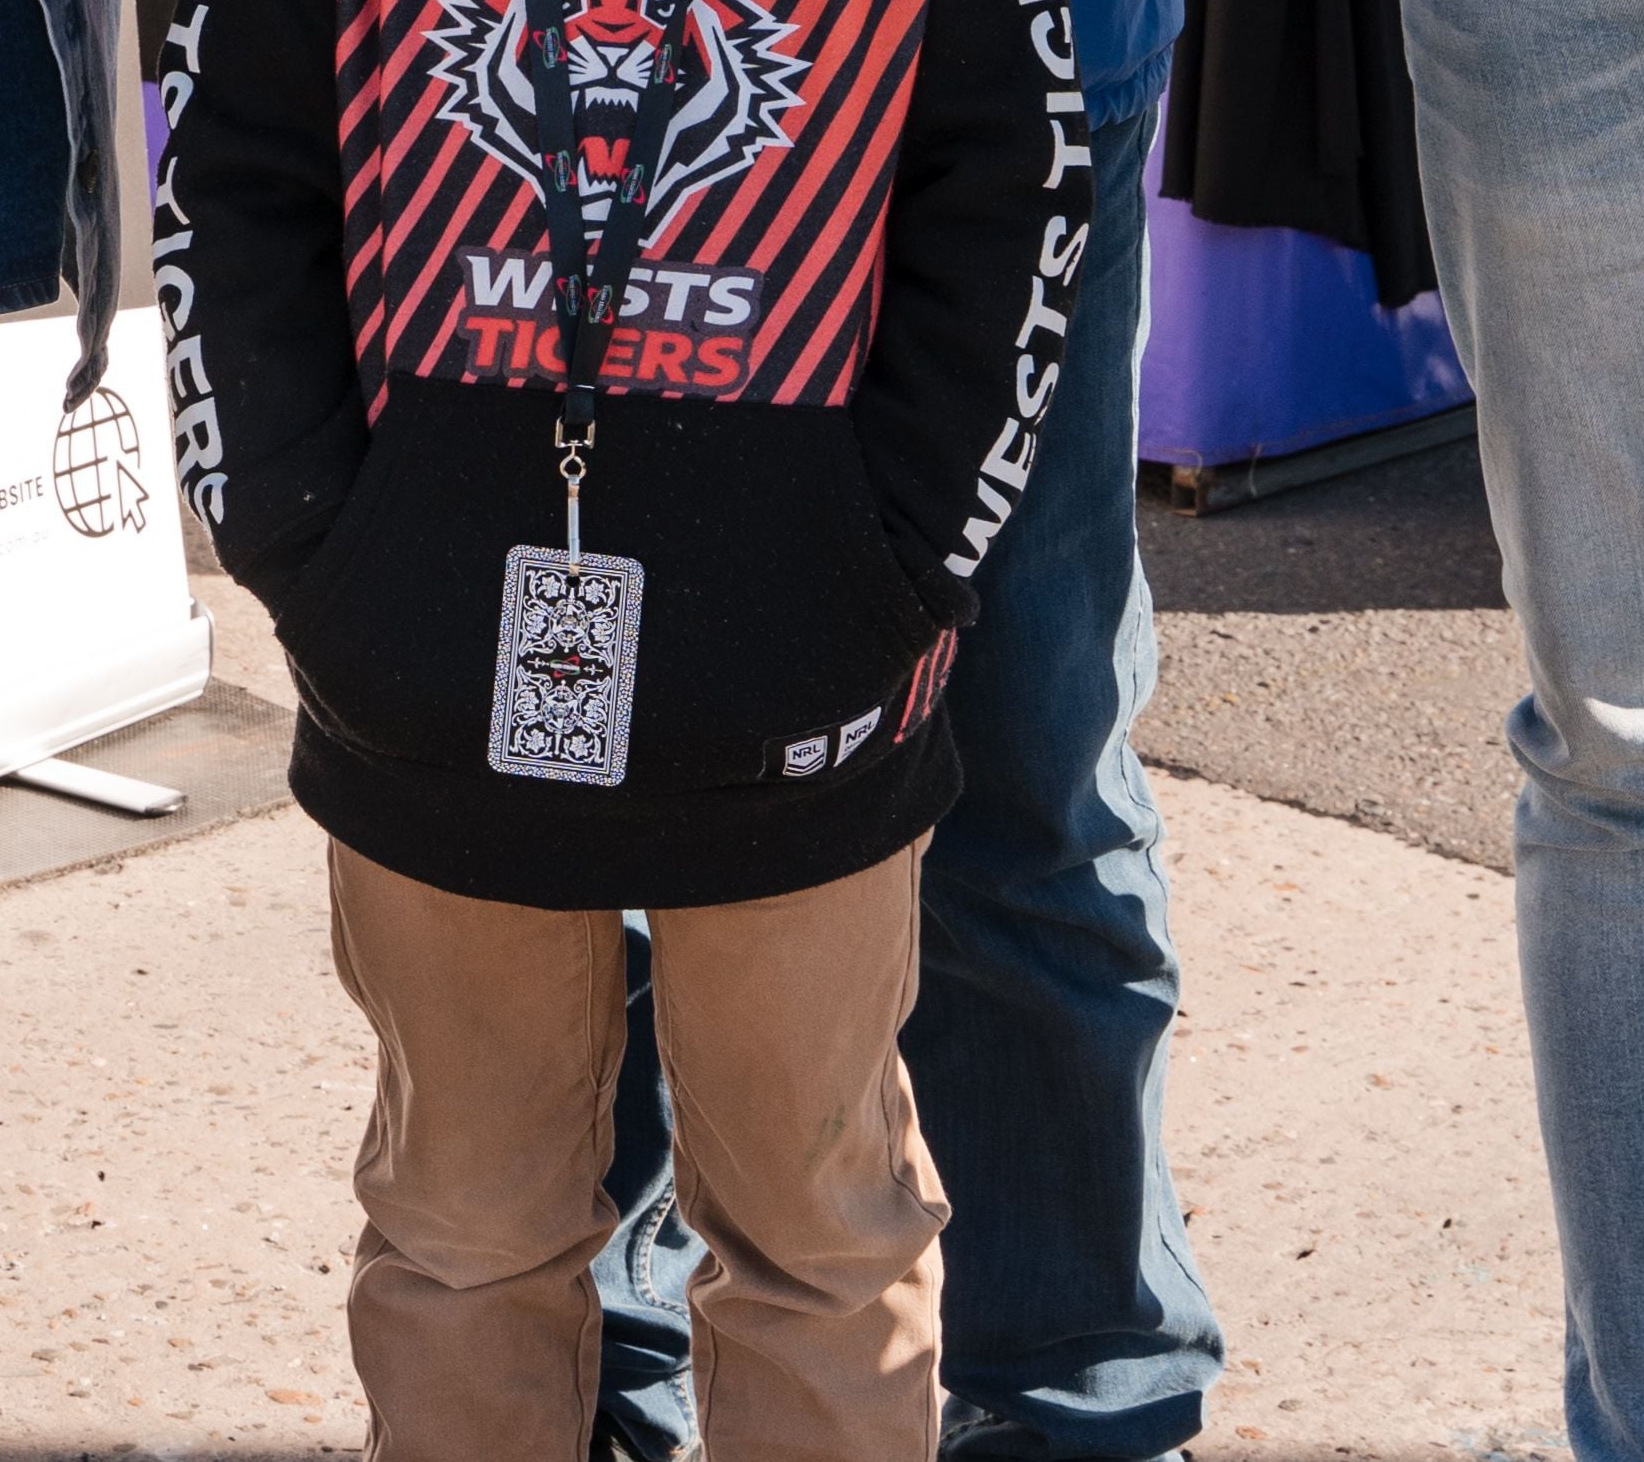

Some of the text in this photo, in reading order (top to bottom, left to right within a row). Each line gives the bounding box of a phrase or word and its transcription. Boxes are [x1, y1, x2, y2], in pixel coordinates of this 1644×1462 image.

[466, 255, 754, 326] WSTS
[943, 215, 1089, 578] WESTS
[793, 744, 820, 760] NRL
[845, 721, 874, 744] NRL
